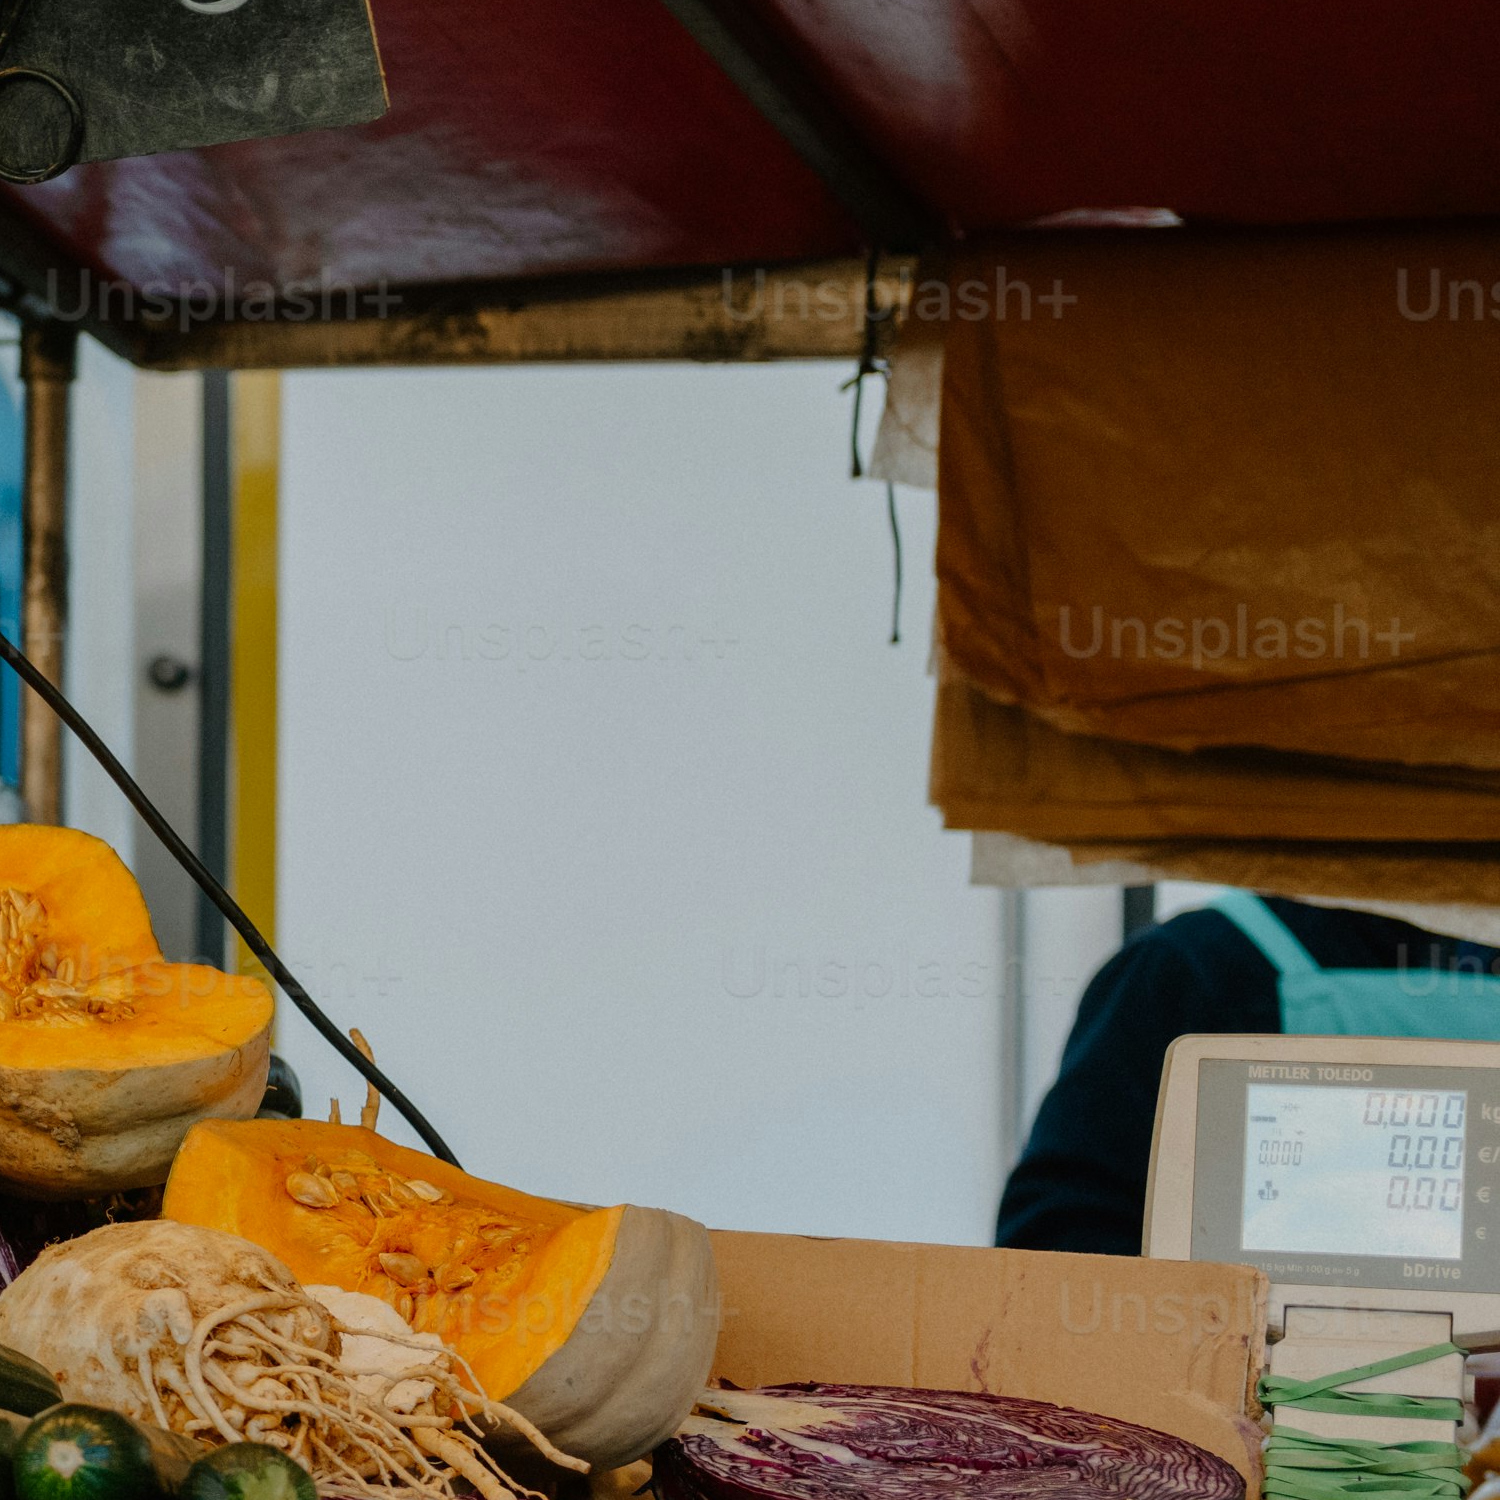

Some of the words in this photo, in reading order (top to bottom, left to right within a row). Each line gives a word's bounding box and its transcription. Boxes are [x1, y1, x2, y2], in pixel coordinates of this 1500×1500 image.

[1248, 1065, 1311, 1080] METTLER
[1316, 1066, 1374, 1082] TOLEDO
[1363, 1091, 1466, 1129] 0,000
[1387, 1134, 1465, 1171] 0,00
[1386, 1175, 1462, 1212] 0,00
[1476, 1186, 1492, 1203] €
[1475, 1226, 1487, 1240] €
[1306, 1264, 1324, 1274] 100
[1403, 1262, 1462, 1280] bDrive
